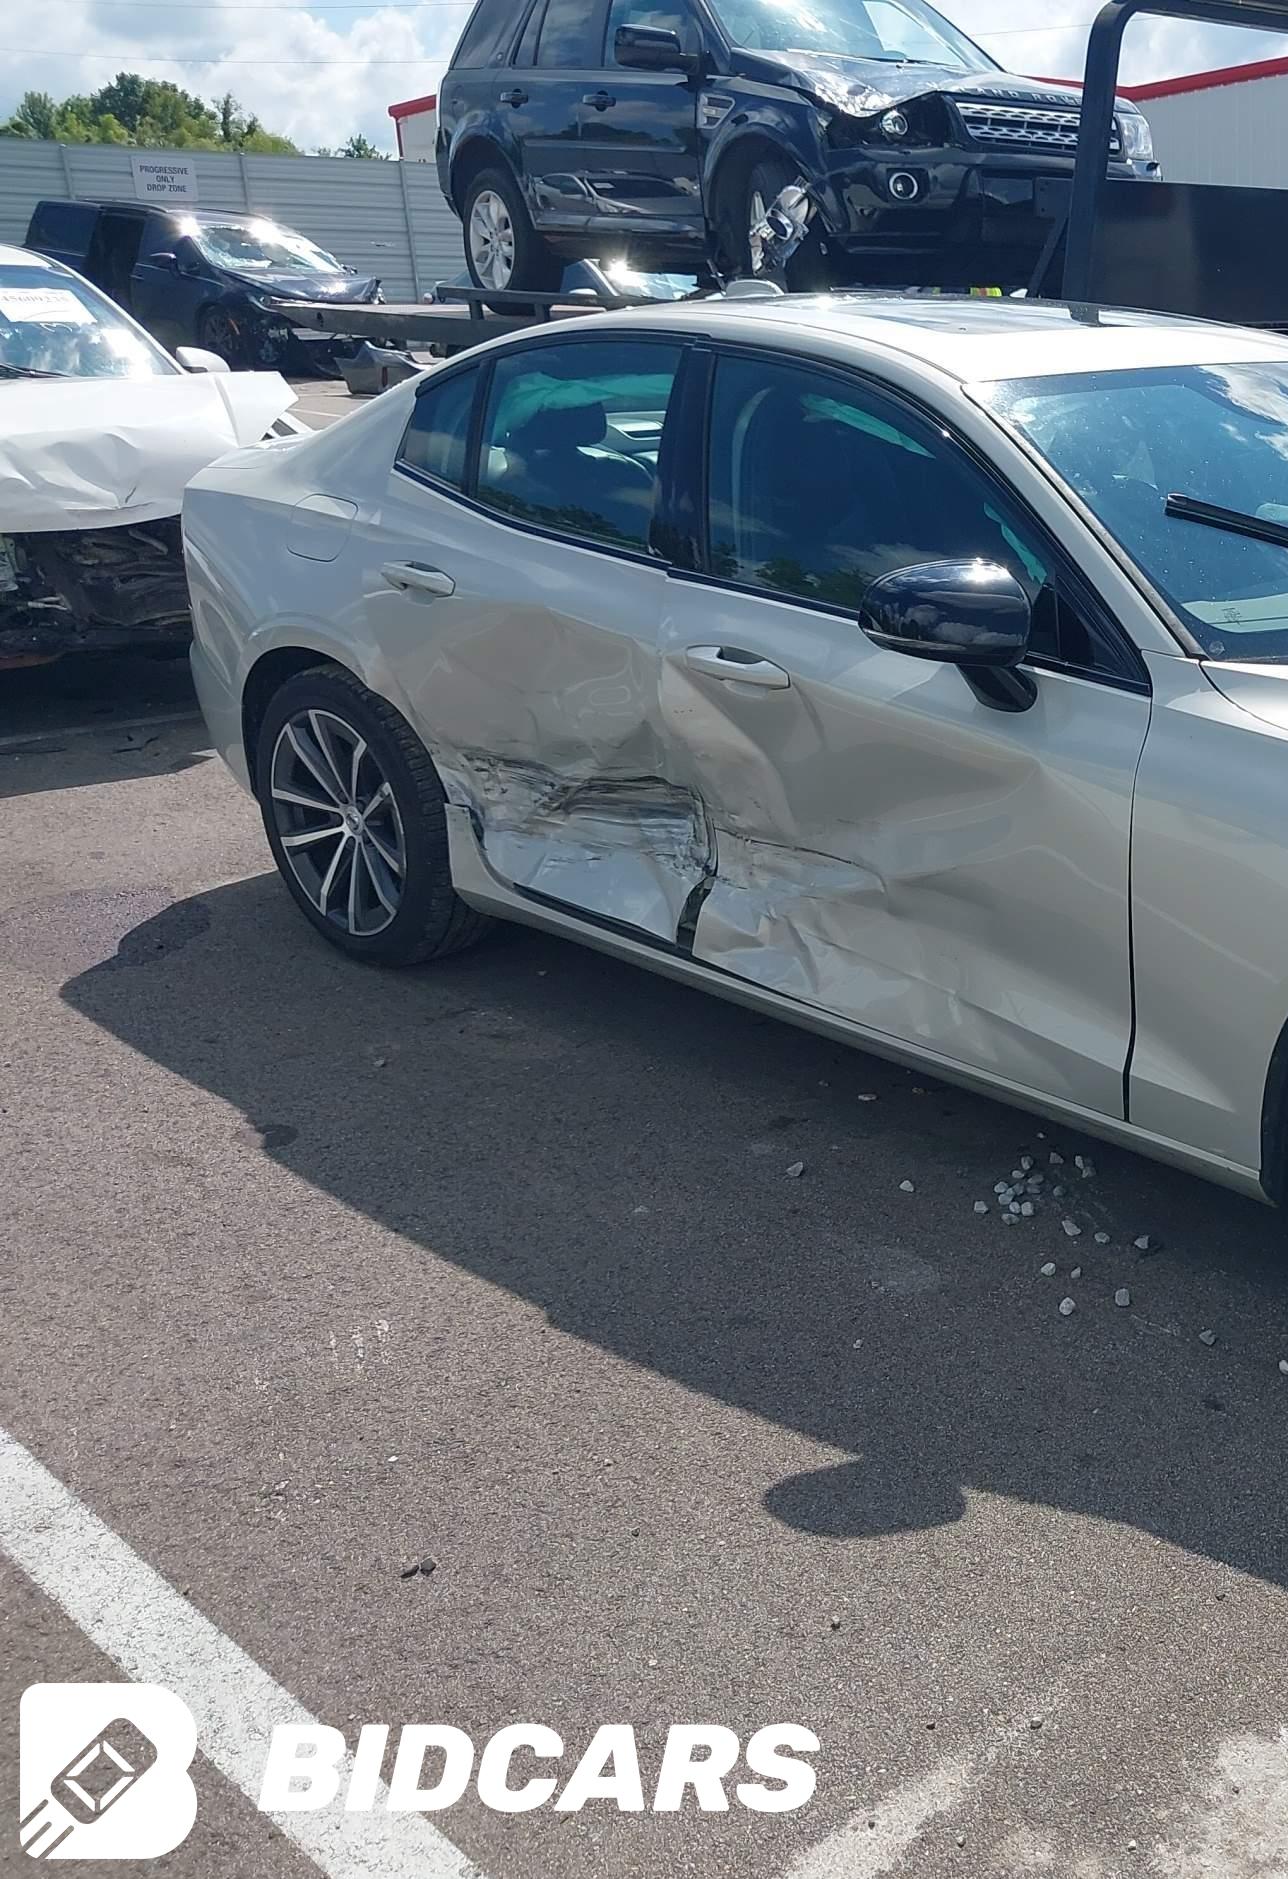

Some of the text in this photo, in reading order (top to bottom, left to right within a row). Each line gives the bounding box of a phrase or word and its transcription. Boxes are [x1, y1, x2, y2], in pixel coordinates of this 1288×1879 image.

[1031, 93, 1083, 106] ROVE
[139, 165, 189, 175] PROGRESSIVE
[155, 175, 175, 183] ONLY
[146, 183, 187, 193] DROP ZONE
